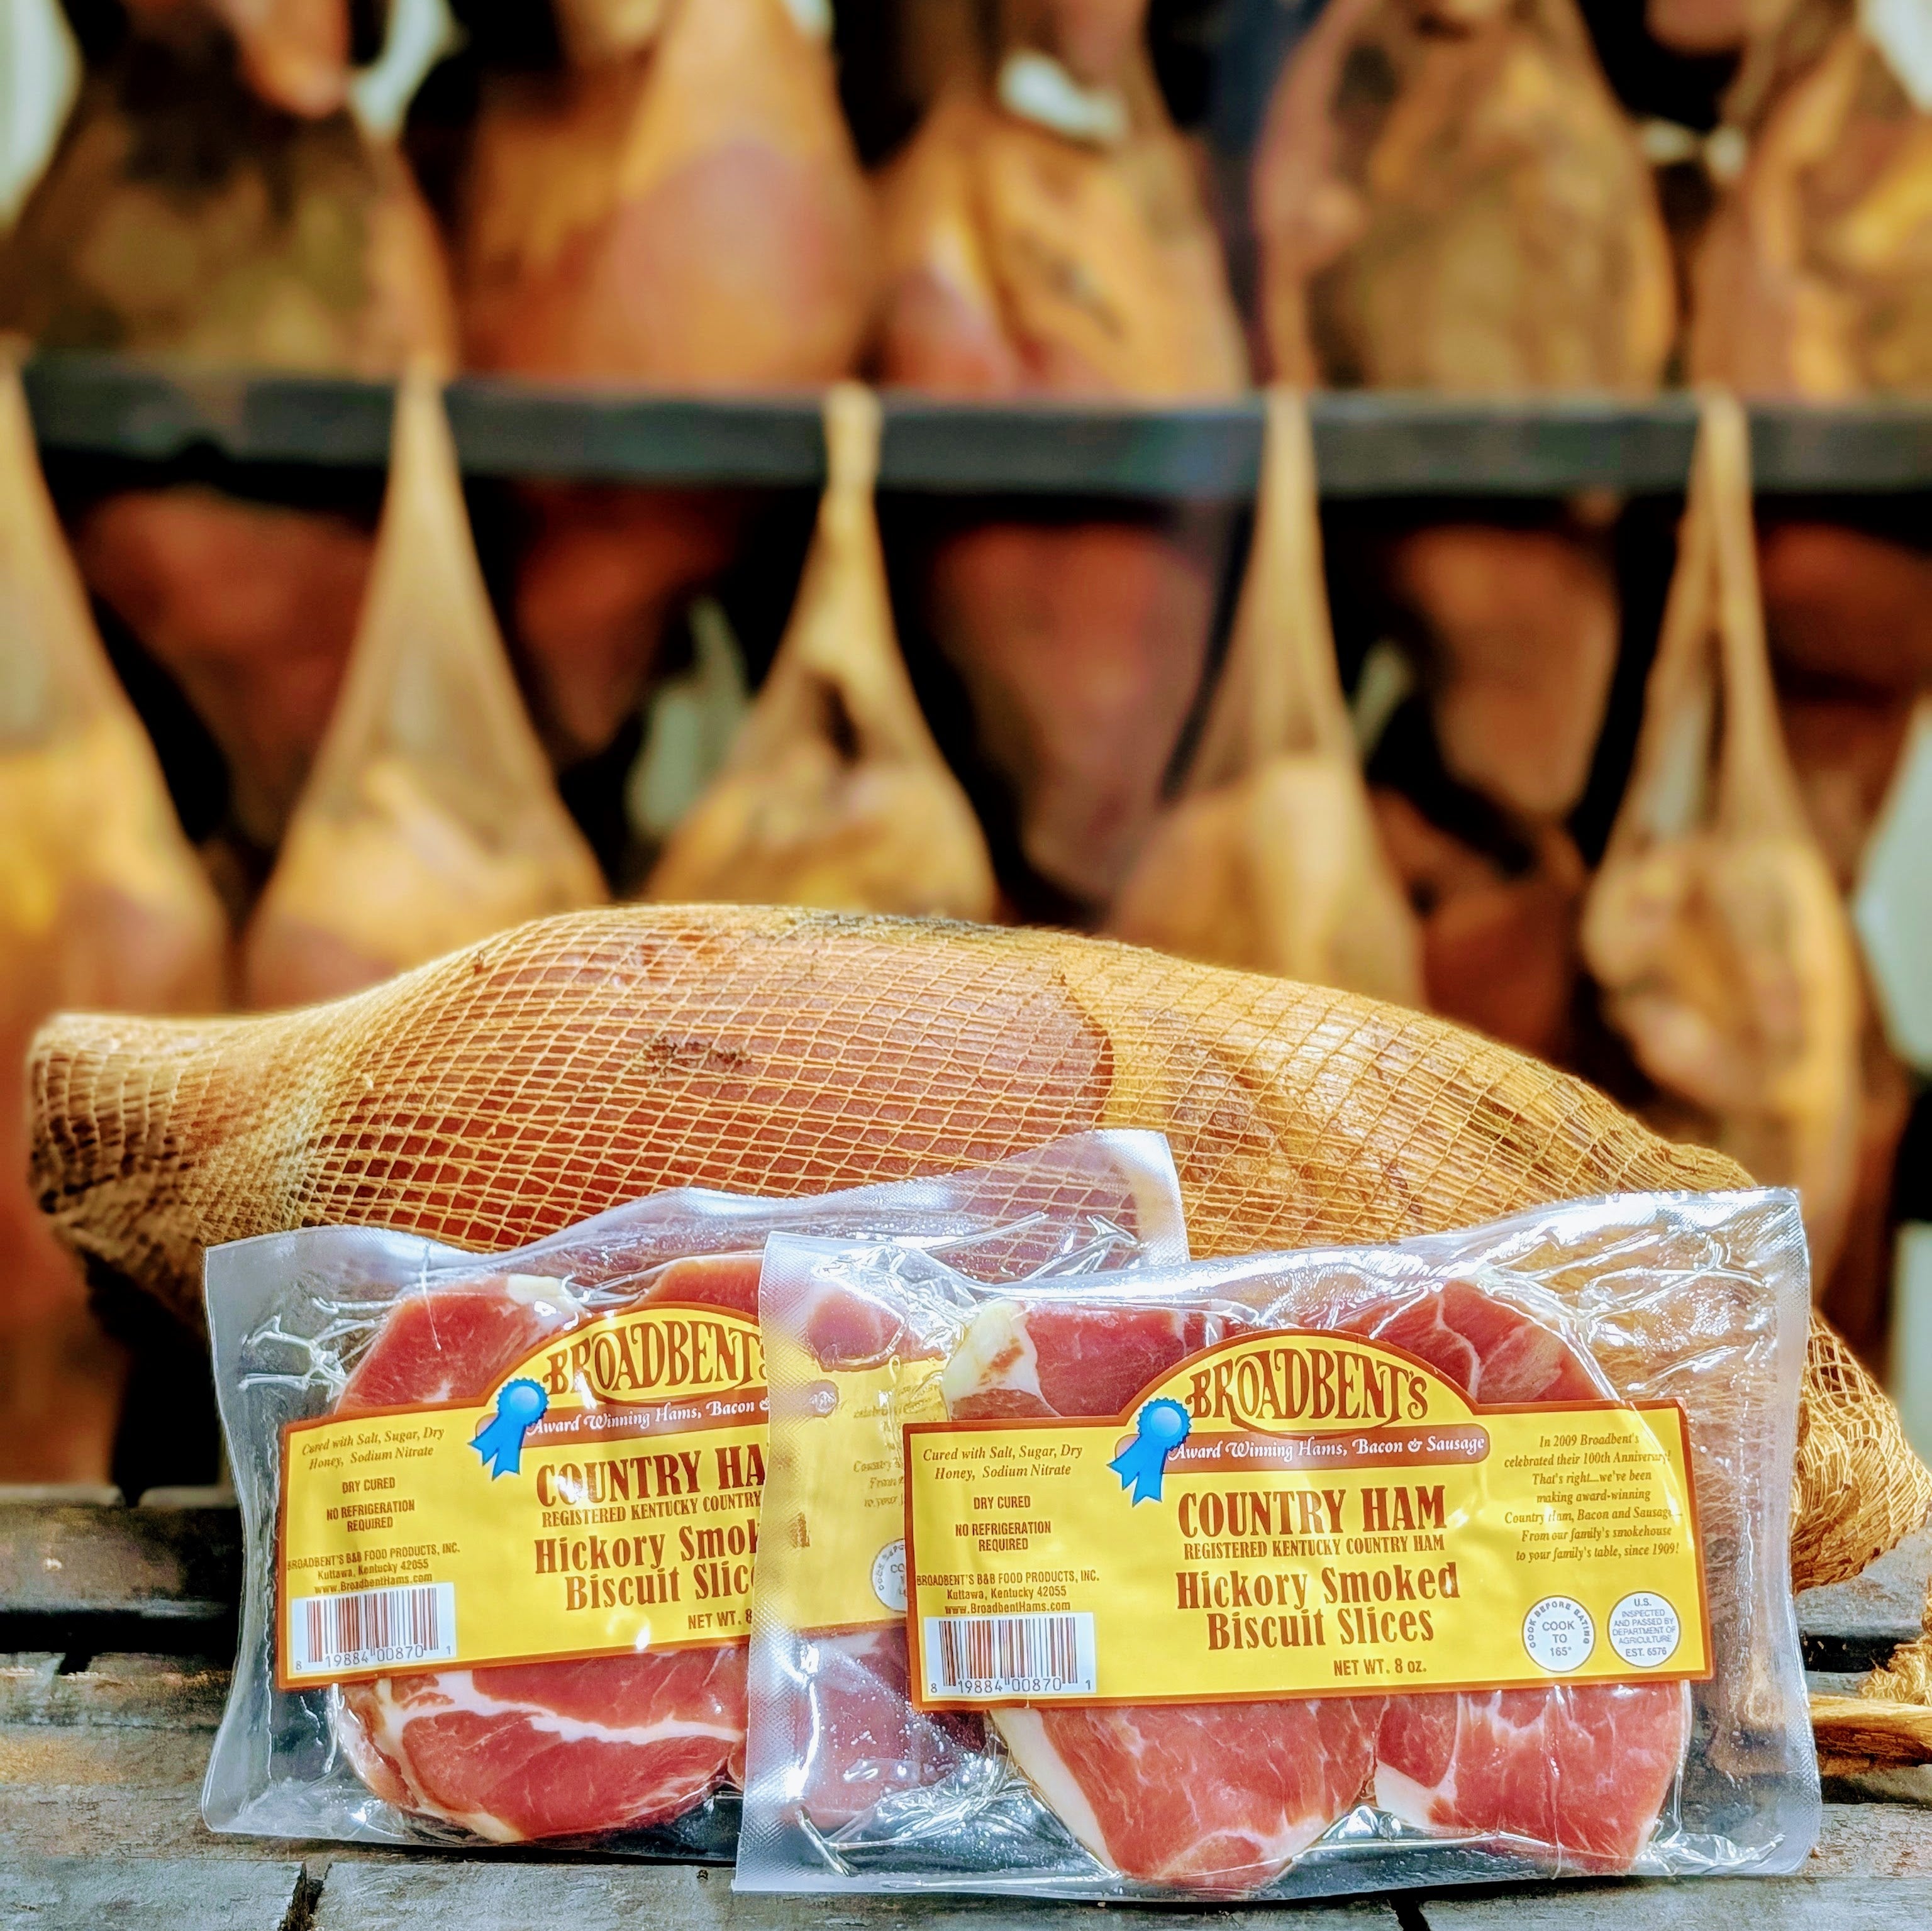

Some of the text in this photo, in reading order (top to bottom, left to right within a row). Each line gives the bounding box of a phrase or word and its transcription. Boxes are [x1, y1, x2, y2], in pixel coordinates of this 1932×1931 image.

[1185, 1347, 1428, 1430] BROADBENT'S
[526, 1414, 582, 1436] Award
[583, 1410, 651, 1429] Winning
[655, 1403, 702, 1422] Hams,
[706, 1400, 755, 1415] Bacon
[302, 1426, 445, 1455] Cured with Salt, Sugar, Dry
[1540, 1433, 1639, 1447] In 2009 Broadbent's
[923, 1444, 1082, 1461] Cured with Salt, Sugar, Dry
[1167, 1436, 1485, 1462] Award Winning Hams, Bacon & Sausage
[308, 1446, 434, 1470] Honey, Sodium Nitrate
[1504, 1454, 1553, 1468] celebrated
[1557, 1453, 1580, 1465] their
[1583, 1452, 1610, 1464] 100th
[536, 1443, 769, 1507] COUNTRY HA
[935, 1464, 1071, 1481] Honey, Sodium Nitrate
[1532, 1473, 1563, 1485] That's
[1629, 1471, 1652, 1480] been
[342, 1476, 396, 1494] DRY CURED
[974, 1495, 1031, 1510] DRY CURED
[1537, 1489, 1651, 1505] making award-winning
[326, 1499, 415, 1520] NO REFRIGERATION
[542, 1491, 761, 1527] REGISTERED KENTUCKY COUNTRY
[1178, 1485, 1446, 1538] COUNTRY HAM
[1505, 1512, 1545, 1525] Country
[1577, 1510, 1609, 1521] Bacon
[1612, 1507, 1631, 1519] and
[347, 1517, 394, 1532] REQUIRED
[955, 1521, 1052, 1536] NO REFRIGERATION
[1522, 1525, 1672, 1542] From our family's smokehouse
[535, 1534, 665, 1574] Hickory
[679, 1519, 760, 1561] Smok
[979, 1538, 1028, 1552] REQUIRED
[1184, 1534, 1445, 1560] REGISTERED KENTUCKY COUNTRY HAM
[1516, 1542, 1679, 1563] to your family's table, since 1909!
[287, 1554, 344, 1571] BROADBENT'S
[365, 1549, 387, 1561] FOOD
[390, 1544, 440, 1558] PRODUCTS,
[442, 1542, 460, 1553] INC.
[358, 1563, 398, 1576] Kentucky
[401, 1559, 428, 1569] 42055
[891, 1563, 906, 1573] CO
[565, 1561, 755, 1610] Biscuit Slic
[917, 1574, 974, 1586] BROADBENT'S
[977, 1574, 995, 1585] B&B
[999, 1573, 1023, 1584] FOOD
[1026, 1571, 1078, 1584] PRODUCTS,
[1080, 1569, 1100, 1582] INC.
[1175, 1561, 1460, 1610] Hickory Smoked
[947, 1586, 1067, 1601] Kuttawa, Kentucky 42055
[688, 1613, 713, 1629] NET
[716, 1611, 741, 1627] WT.
[1622, 1609, 1665, 1617] INSPECTED
[1207, 1607, 1435, 1651] Biscuit Slices
[1542, 1620, 1575, 1631] COOK
[1613, 1627, 1663, 1635] DEPARTMENT
[1553, 1634, 1567, 1643] TO
[1619, 1635, 1672, 1645] AGRICULTURE
[325, 1653, 369, 1668] 19884
[377, 1645, 424, 1662] 00870
[446, 1646, 451, 1655] 1
[1626, 1648, 1645, 1657] EST.
[1334, 1658, 1427, 1676] NET WT. 8 oz.
[931, 1678, 1091, 1693] 8 19884 00870 1
